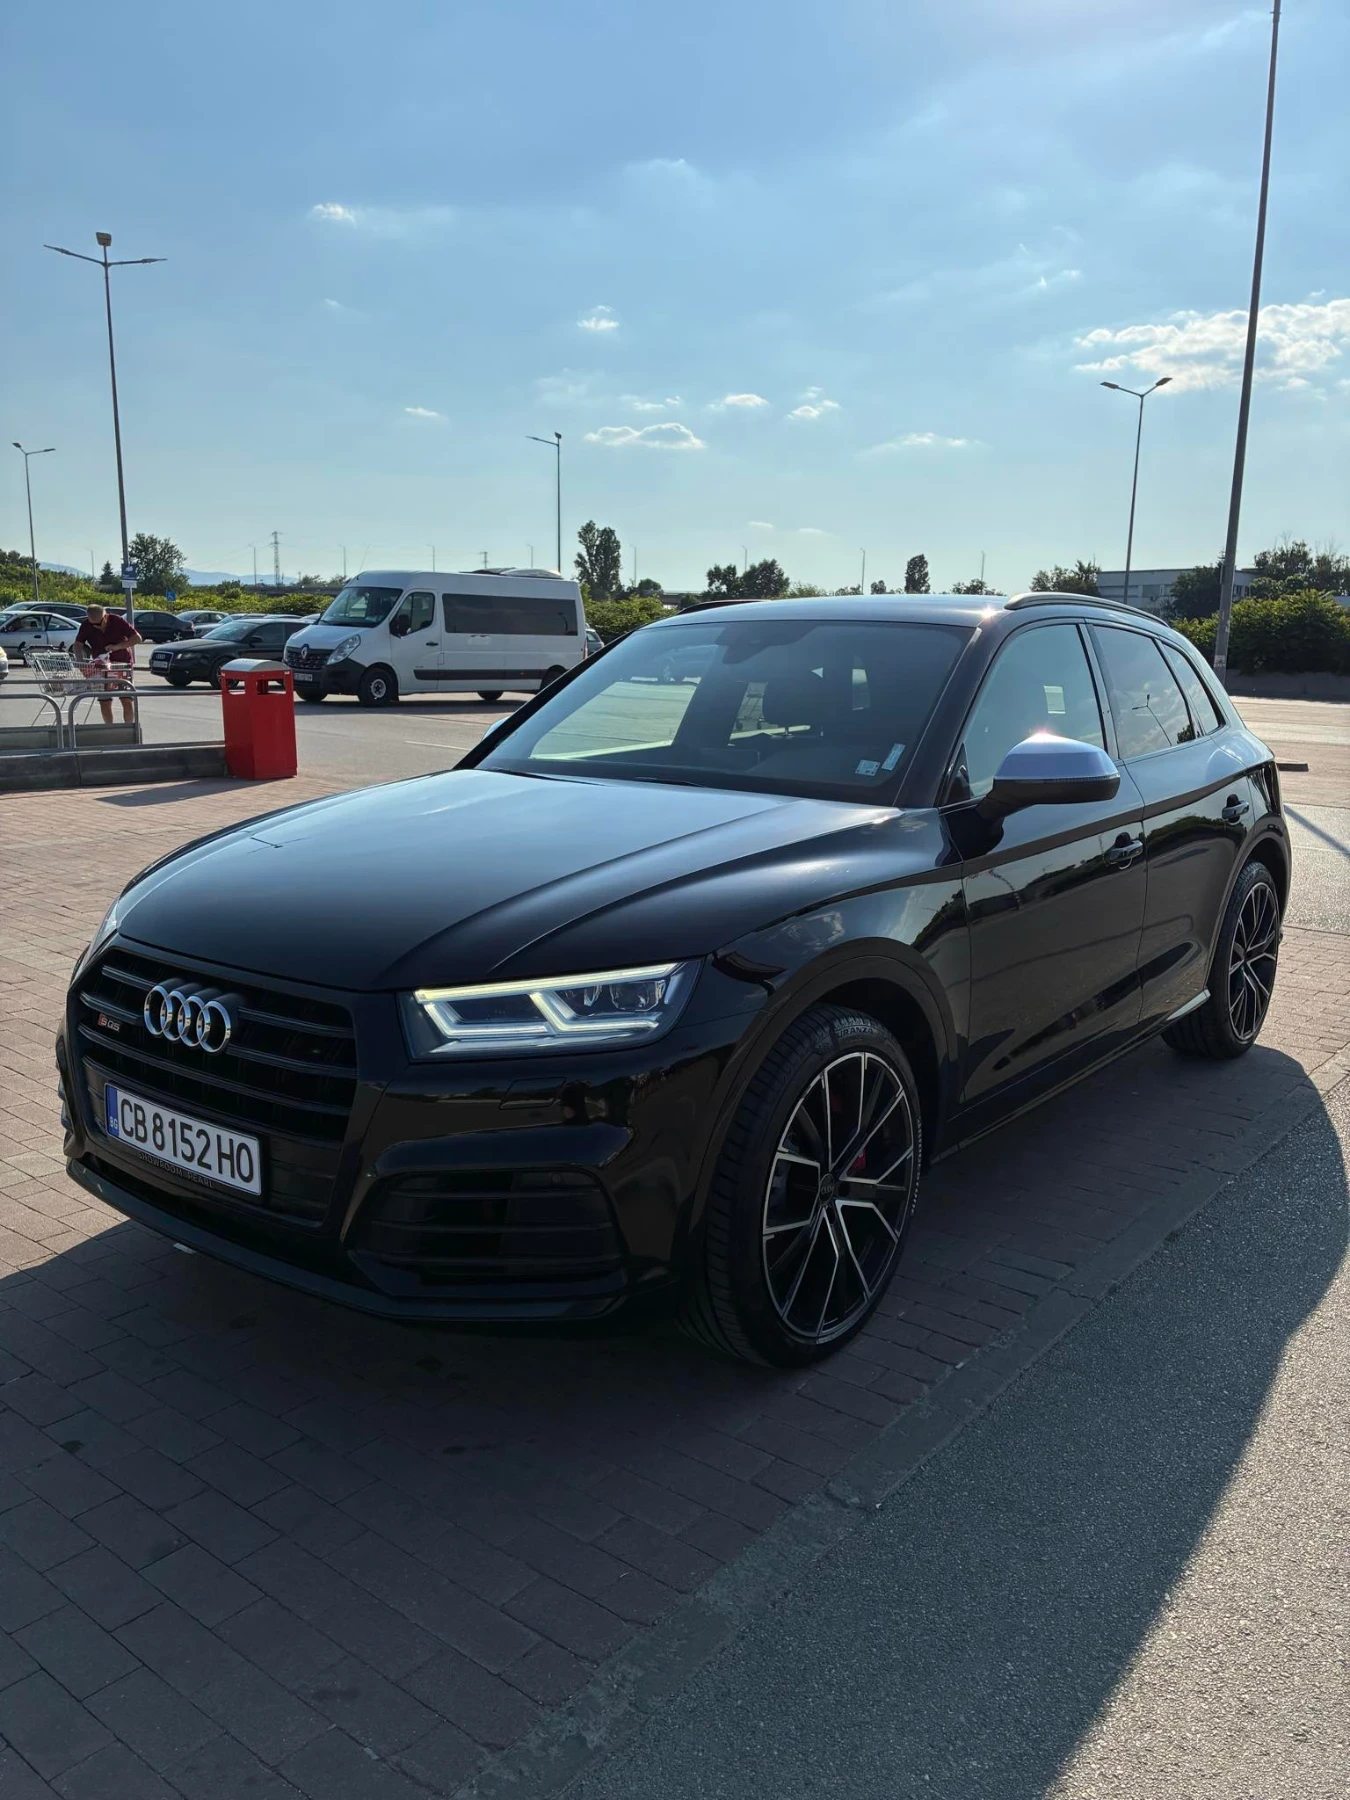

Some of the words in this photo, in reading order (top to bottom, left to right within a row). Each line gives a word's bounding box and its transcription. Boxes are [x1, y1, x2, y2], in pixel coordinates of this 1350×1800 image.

[832, 1027, 873, 1038] URANZA
[109, 1115, 119, 1130] BG
[138, 1151, 183, 1178] SHOWROOM
[187, 1170, 214, 1189] PEARL
